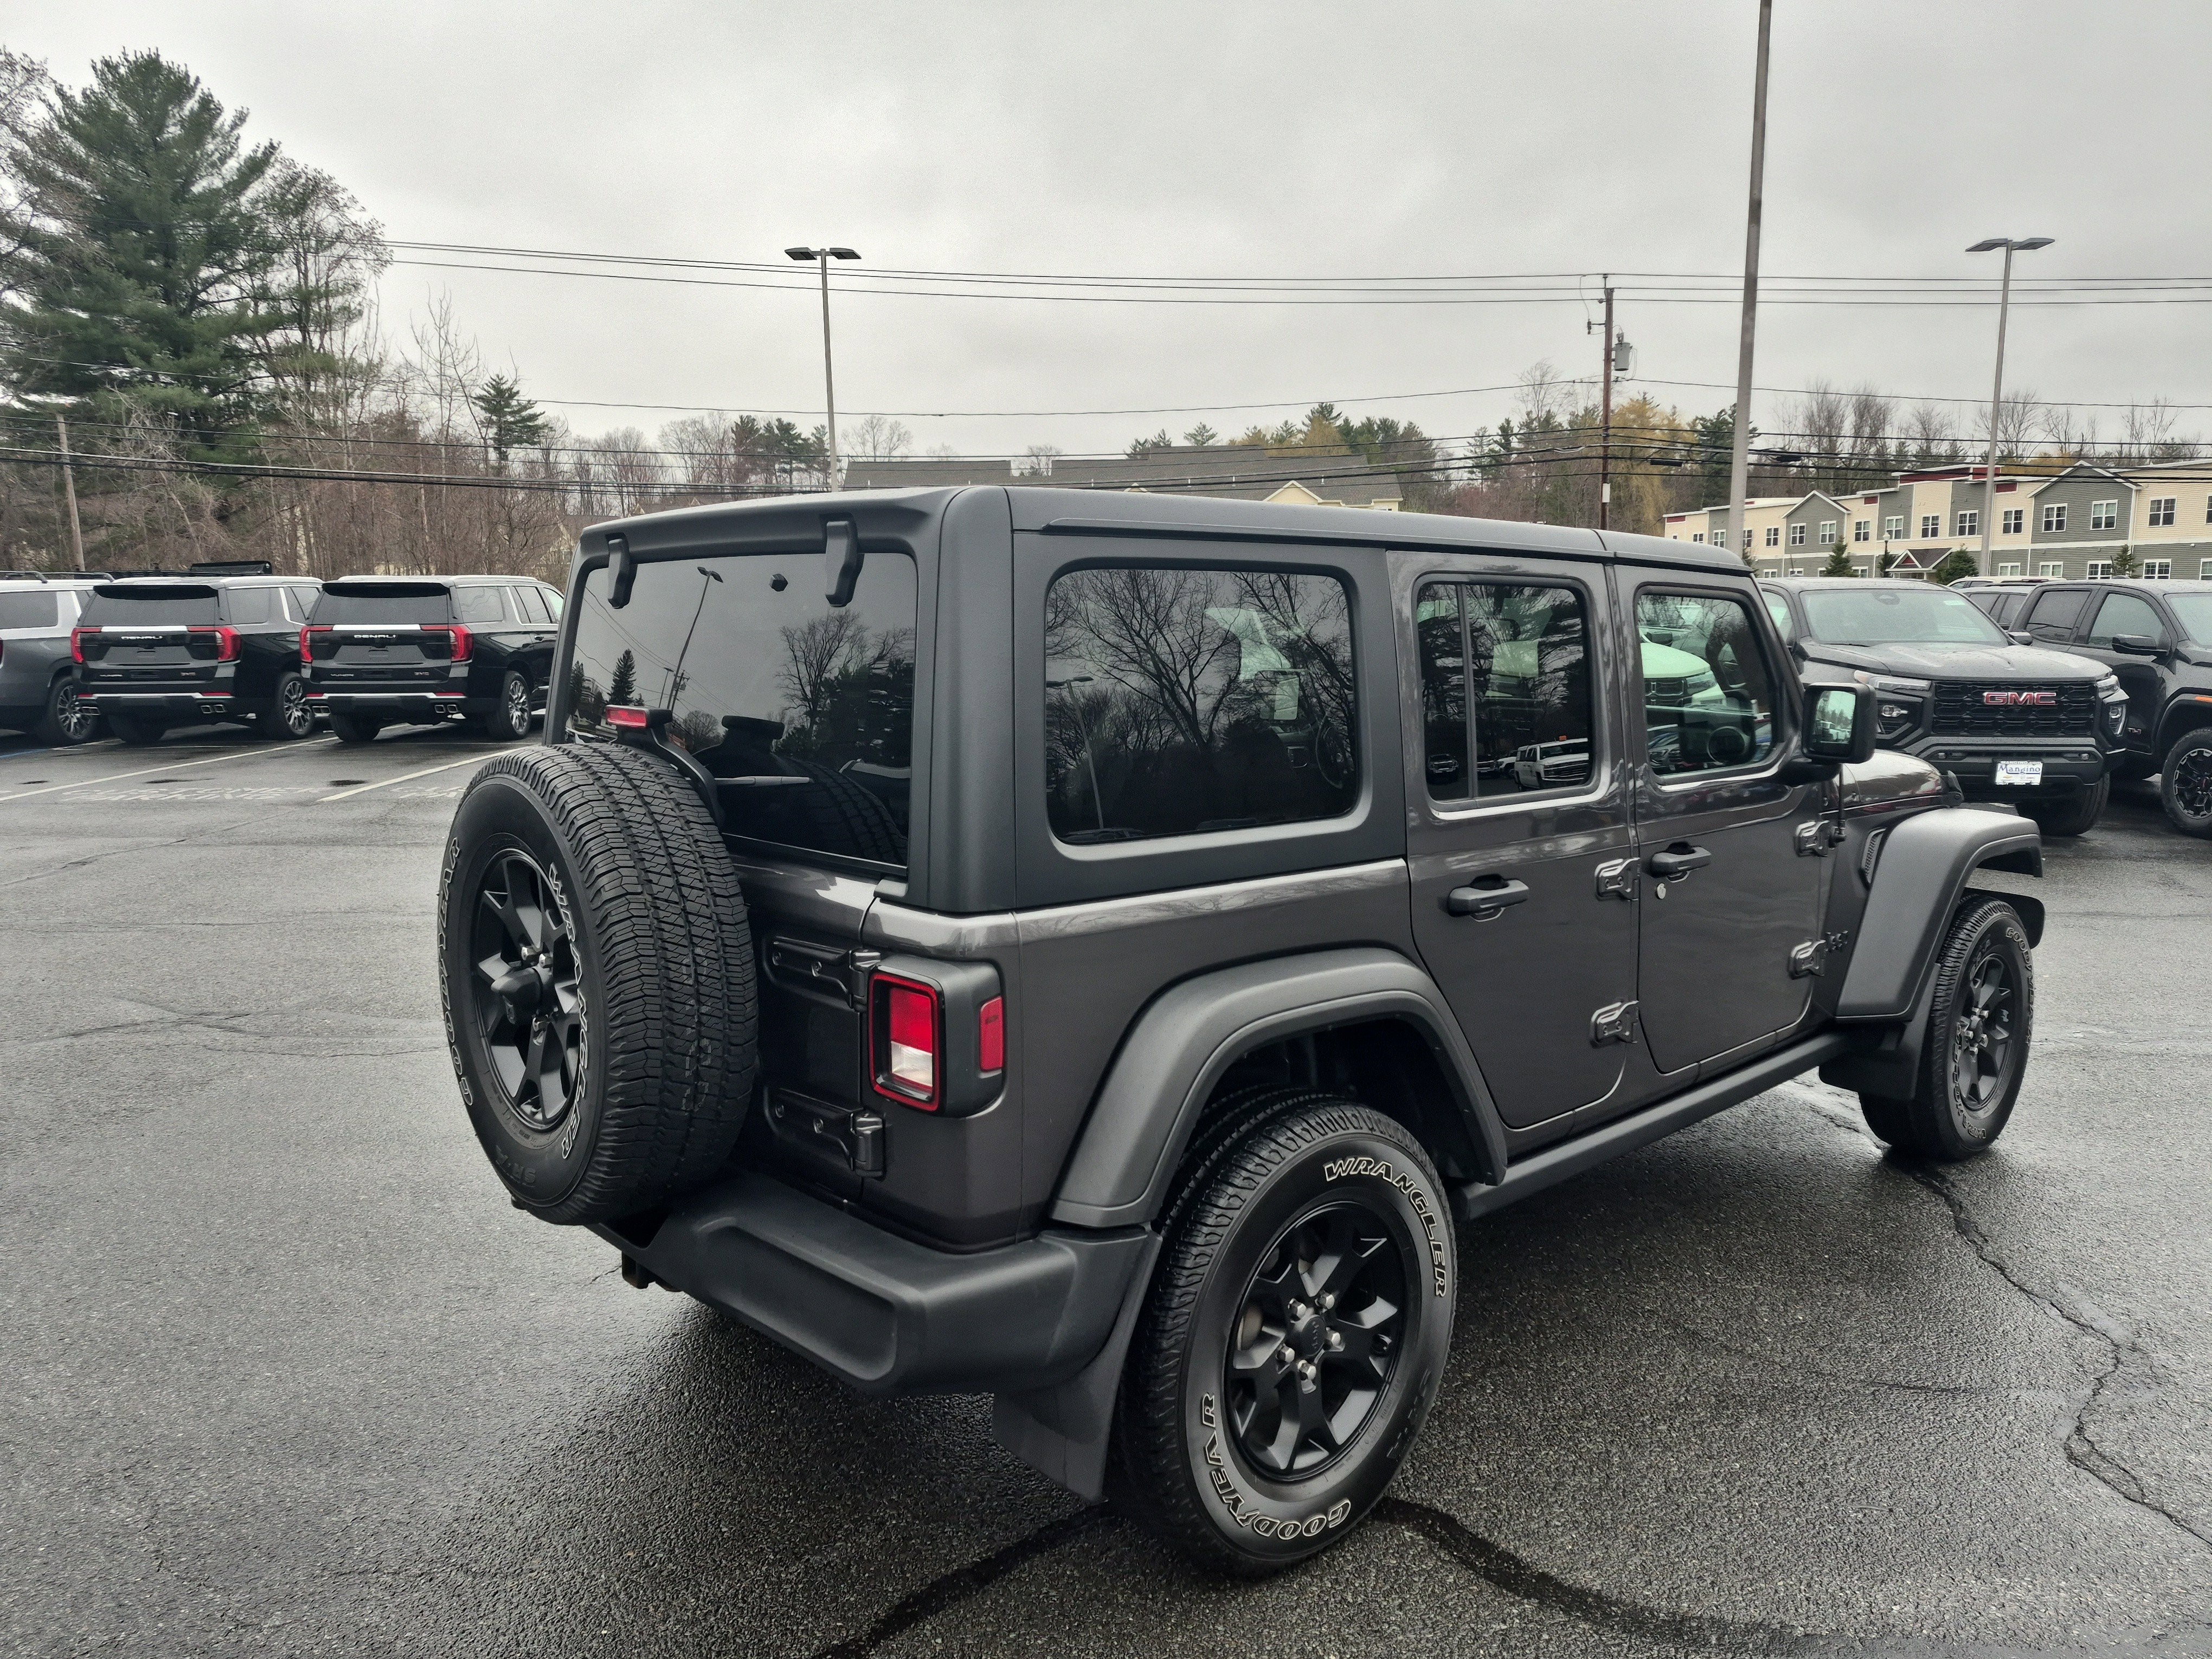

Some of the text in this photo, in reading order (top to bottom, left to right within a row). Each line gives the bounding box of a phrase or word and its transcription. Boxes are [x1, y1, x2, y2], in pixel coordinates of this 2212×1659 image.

[1983, 692, 2056, 705] GMC
[1998, 765, 2041, 775] Mangino
[437, 837, 473, 1106] GOODYEAR
[549, 861, 588, 1160] WRANGLER
[1323, 1156, 1447, 1298] WRANGLER
[1200, 1392, 1352, 1541] GOODYEAR
